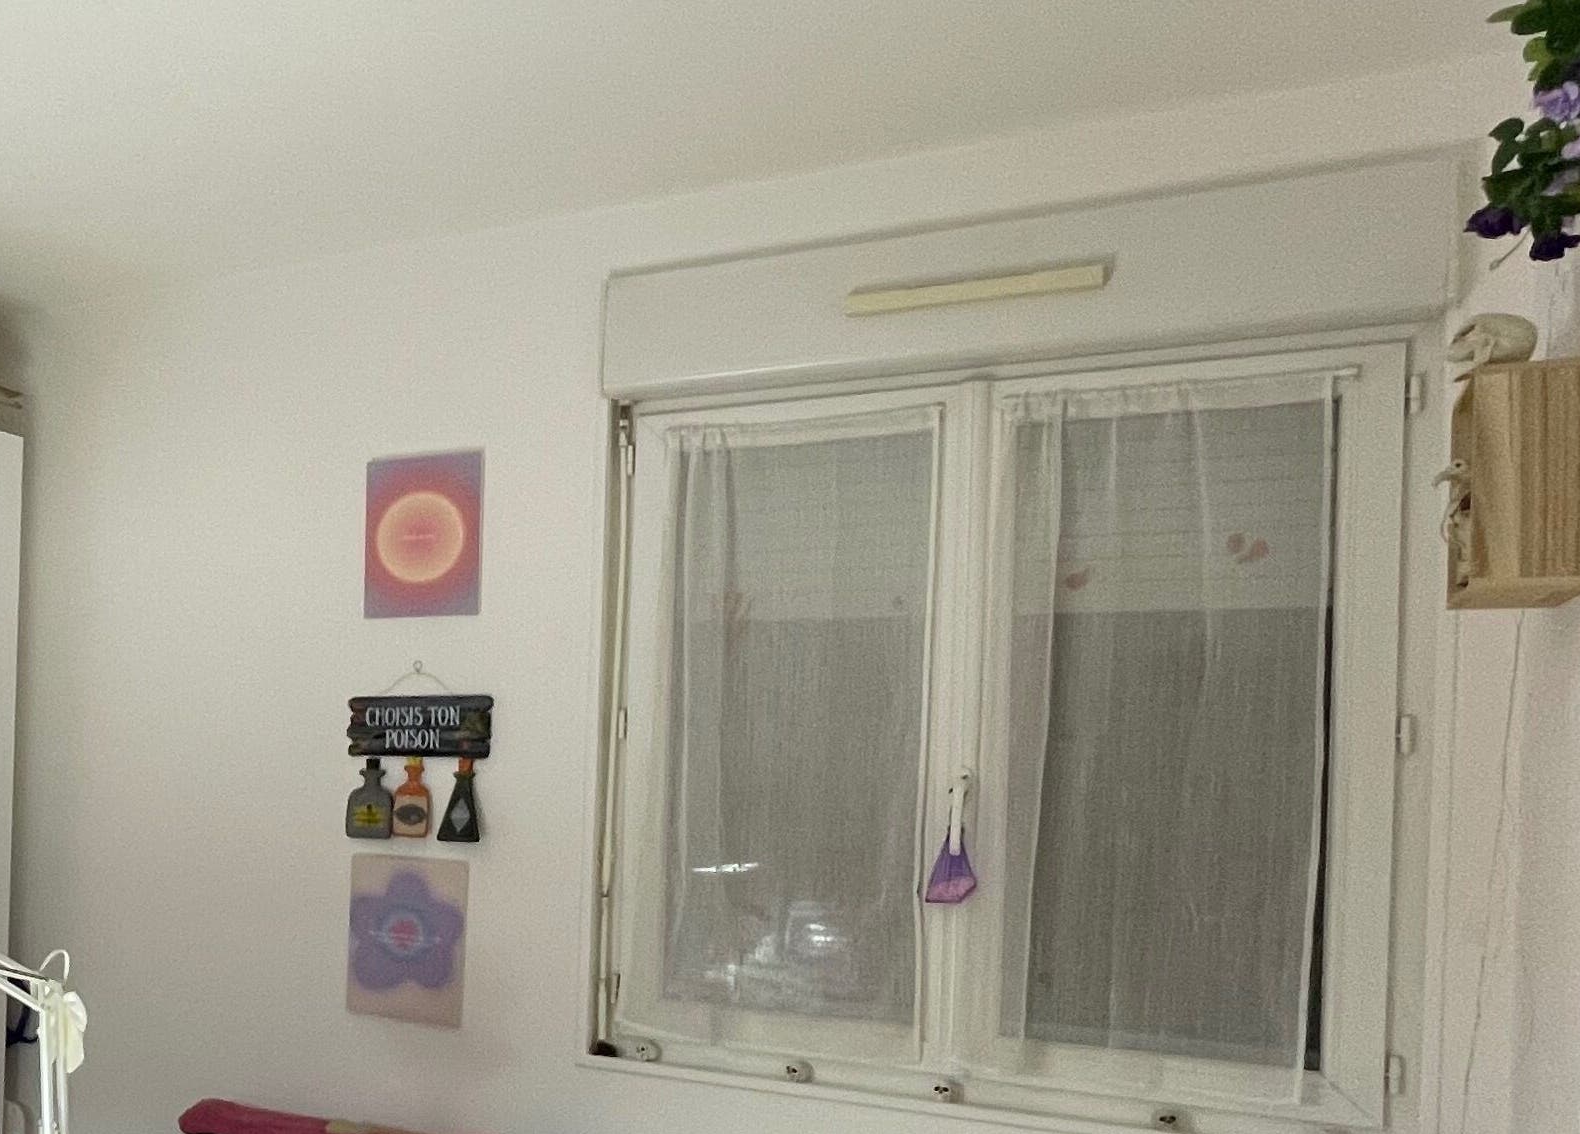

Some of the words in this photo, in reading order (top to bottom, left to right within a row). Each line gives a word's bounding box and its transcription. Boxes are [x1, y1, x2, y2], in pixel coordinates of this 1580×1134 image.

[365, 707, 423, 727] CHOISIS
[427, 706, 460, 727] TON
[385, 729, 440, 750] POISON
